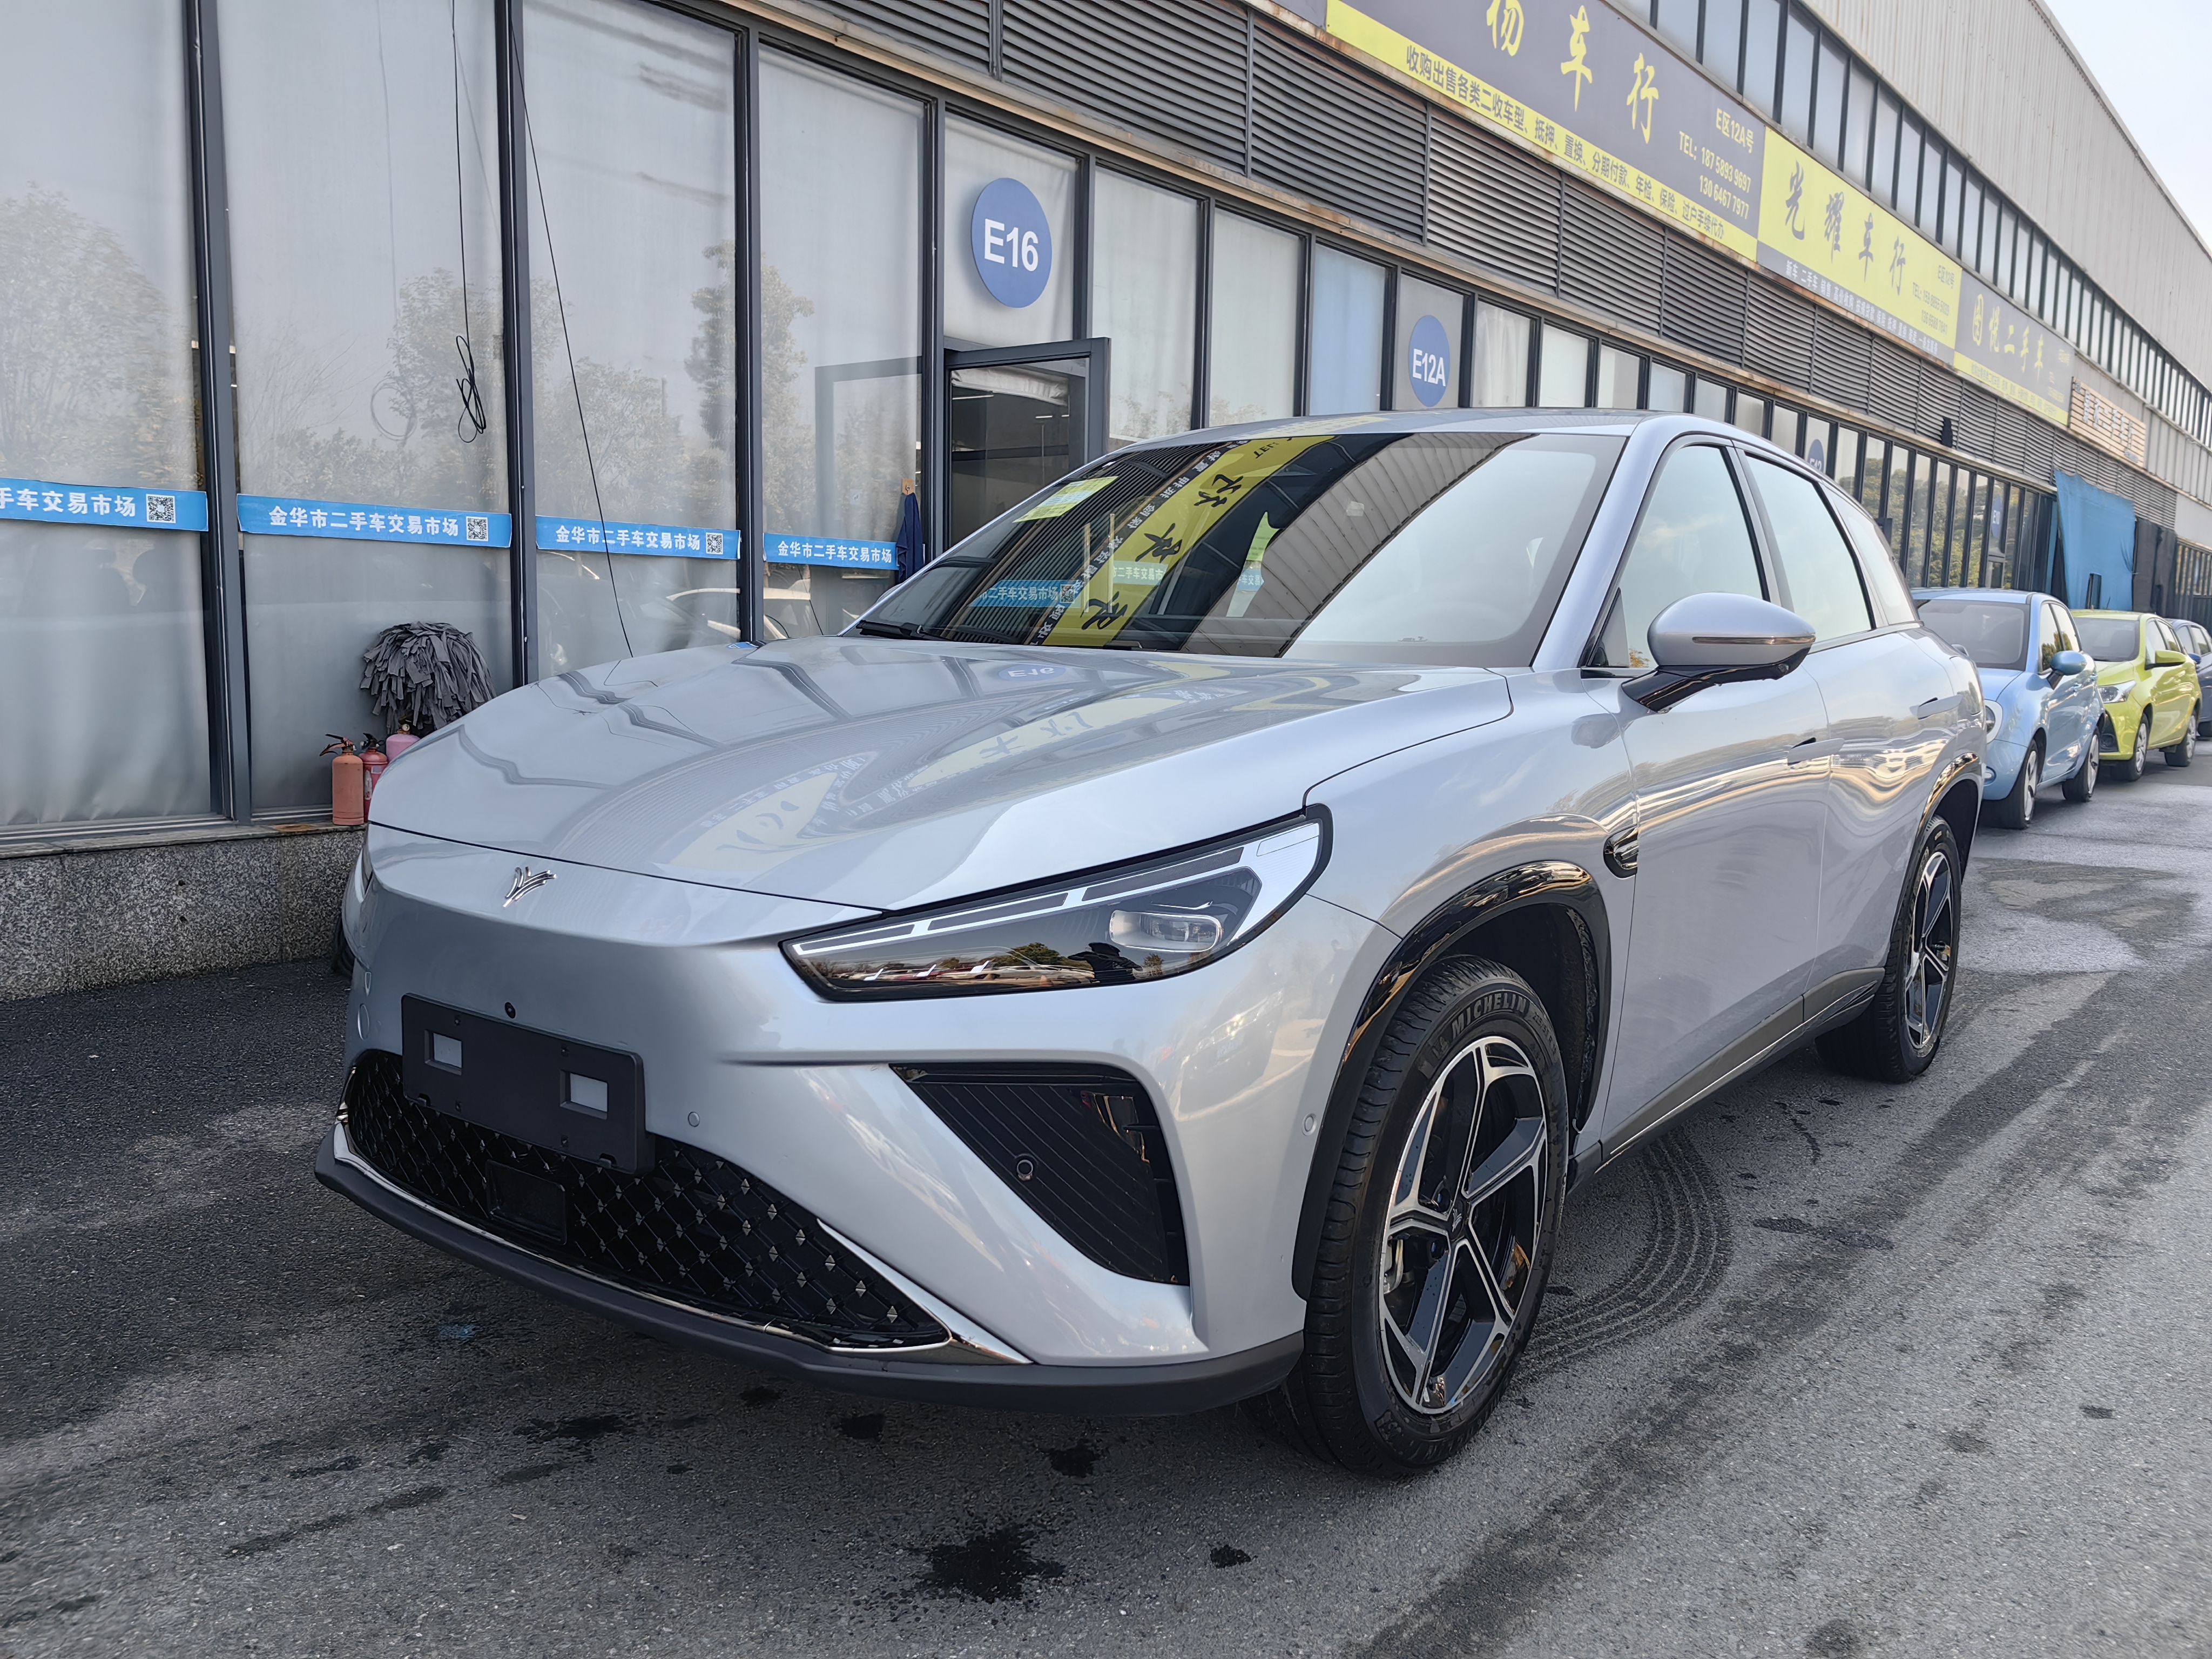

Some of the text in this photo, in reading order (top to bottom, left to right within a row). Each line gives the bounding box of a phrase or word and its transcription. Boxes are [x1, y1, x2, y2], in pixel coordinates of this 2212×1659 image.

[1716, 108, 1754, 153] E区12A号
[1702, 147, 1715, 170] 187
[1716, 156, 1734, 182] 5893
[1734, 169, 1751, 193] 9697
[1700, 175, 1713, 198] 130
[1732, 195, 1750, 219] 7977
[984, 218, 1038, 272] E16
[1800, 268, 1818, 291] 二手车
[1413, 348, 1446, 387] E12A
[269, 505, 458, 536] 金华市二手车交易市场
[556, 525, 700, 551] 金华市二手车交易市场
[778, 541, 892, 563] 金华市二手车交易市场
[1114, 567, 1166, 581] 二手车交易市
[1452, 992, 1527, 1040] MICHELIN
